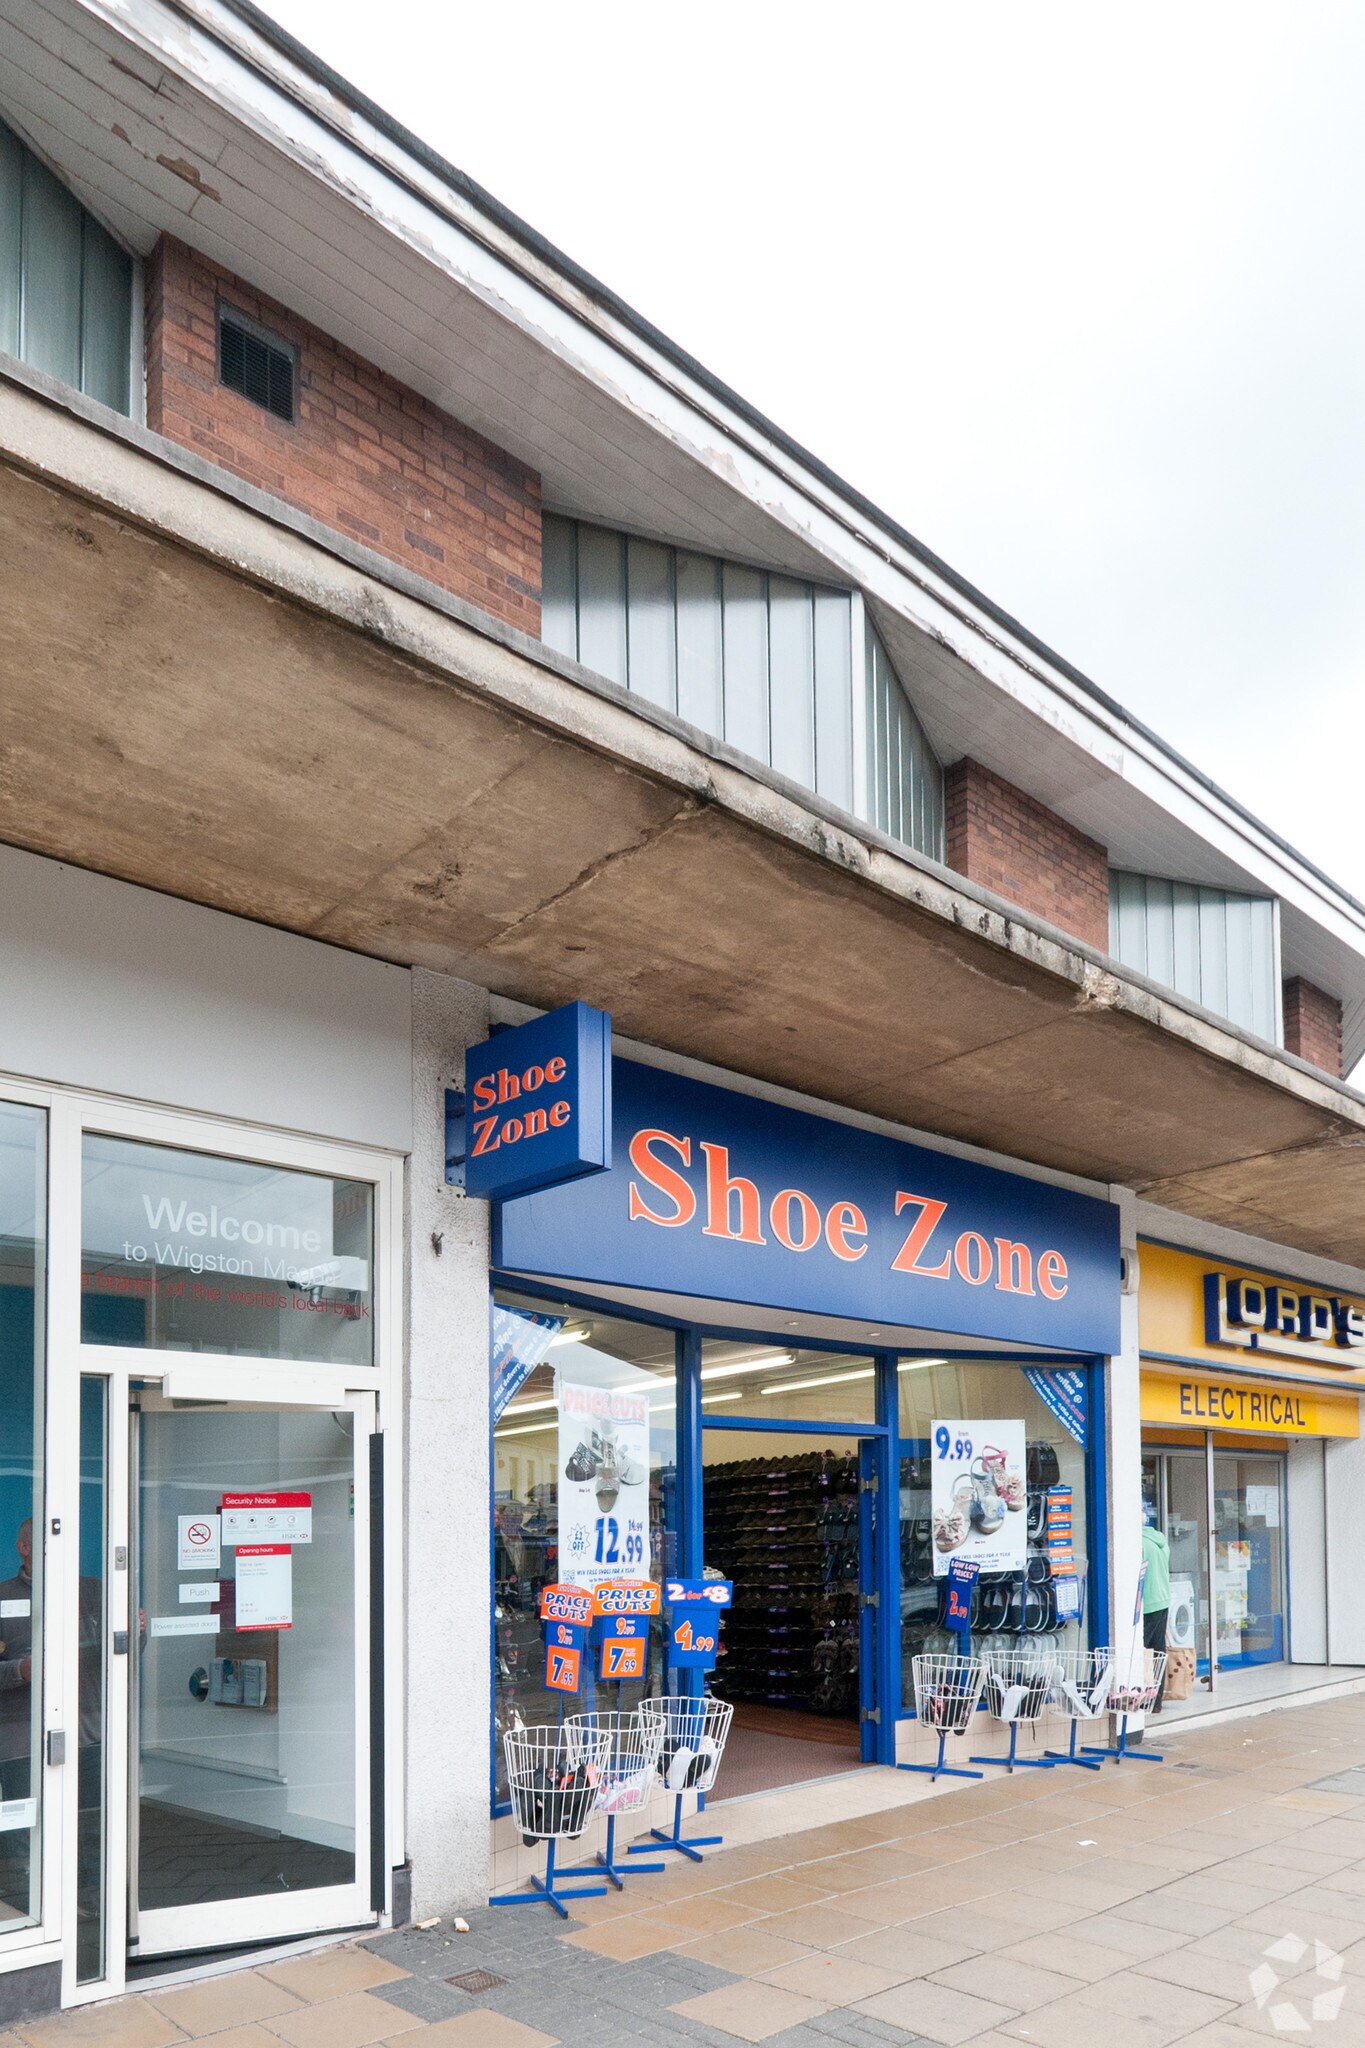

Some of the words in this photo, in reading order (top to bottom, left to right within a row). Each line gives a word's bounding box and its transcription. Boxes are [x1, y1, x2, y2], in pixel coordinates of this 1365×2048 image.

[473, 1056, 566, 1112] Shoe
[471, 1100, 571, 1157] Zone
[142, 1194, 322, 1253] Welcome
[628, 1128, 868, 1262] Shoe
[890, 1190, 1069, 1301] Zone
[122, 1240, 148, 1262] to
[154, 1242, 254, 1274] Wigston
[97, 1270, 160, 1294] branch
[167, 1280, 185, 1297] of
[193, 1282, 221, 1301] the
[227, 1290, 288, 1309] world's
[292, 1293, 329, 1313] local
[333, 1297, 369, 1318] bank
[564, 1387, 609, 1416] PRICE
[1180, 1383, 1306, 1426] ELECTRICAL
[935, 1425, 973, 1460] 9.99
[225, 1497, 253, 1506] Security
[254, 1497, 277, 1505] Notice
[239, 1547, 260, 1555] Opening
[594, 1517, 643, 1564] 12.99
[189, 1588, 210, 1597] Push
[545, 1592, 592, 1610] PRICE
[597, 1588, 657, 1600] PRICE
[601, 1600, 651, 1611] CUTS
[666, 1583, 686, 1601] 2
[687, 1591, 702, 1600] for
[949, 1590, 968, 1619] 2.99
[153, 1622, 173, 1630] Power
[174, 1621, 200, 1629] assisted
[548, 1605, 587, 1621] CUTS
[674, 1620, 714, 1651] 4.99
[552, 1655, 574, 1687] 7.99
[609, 1647, 637, 1673] 7.99
